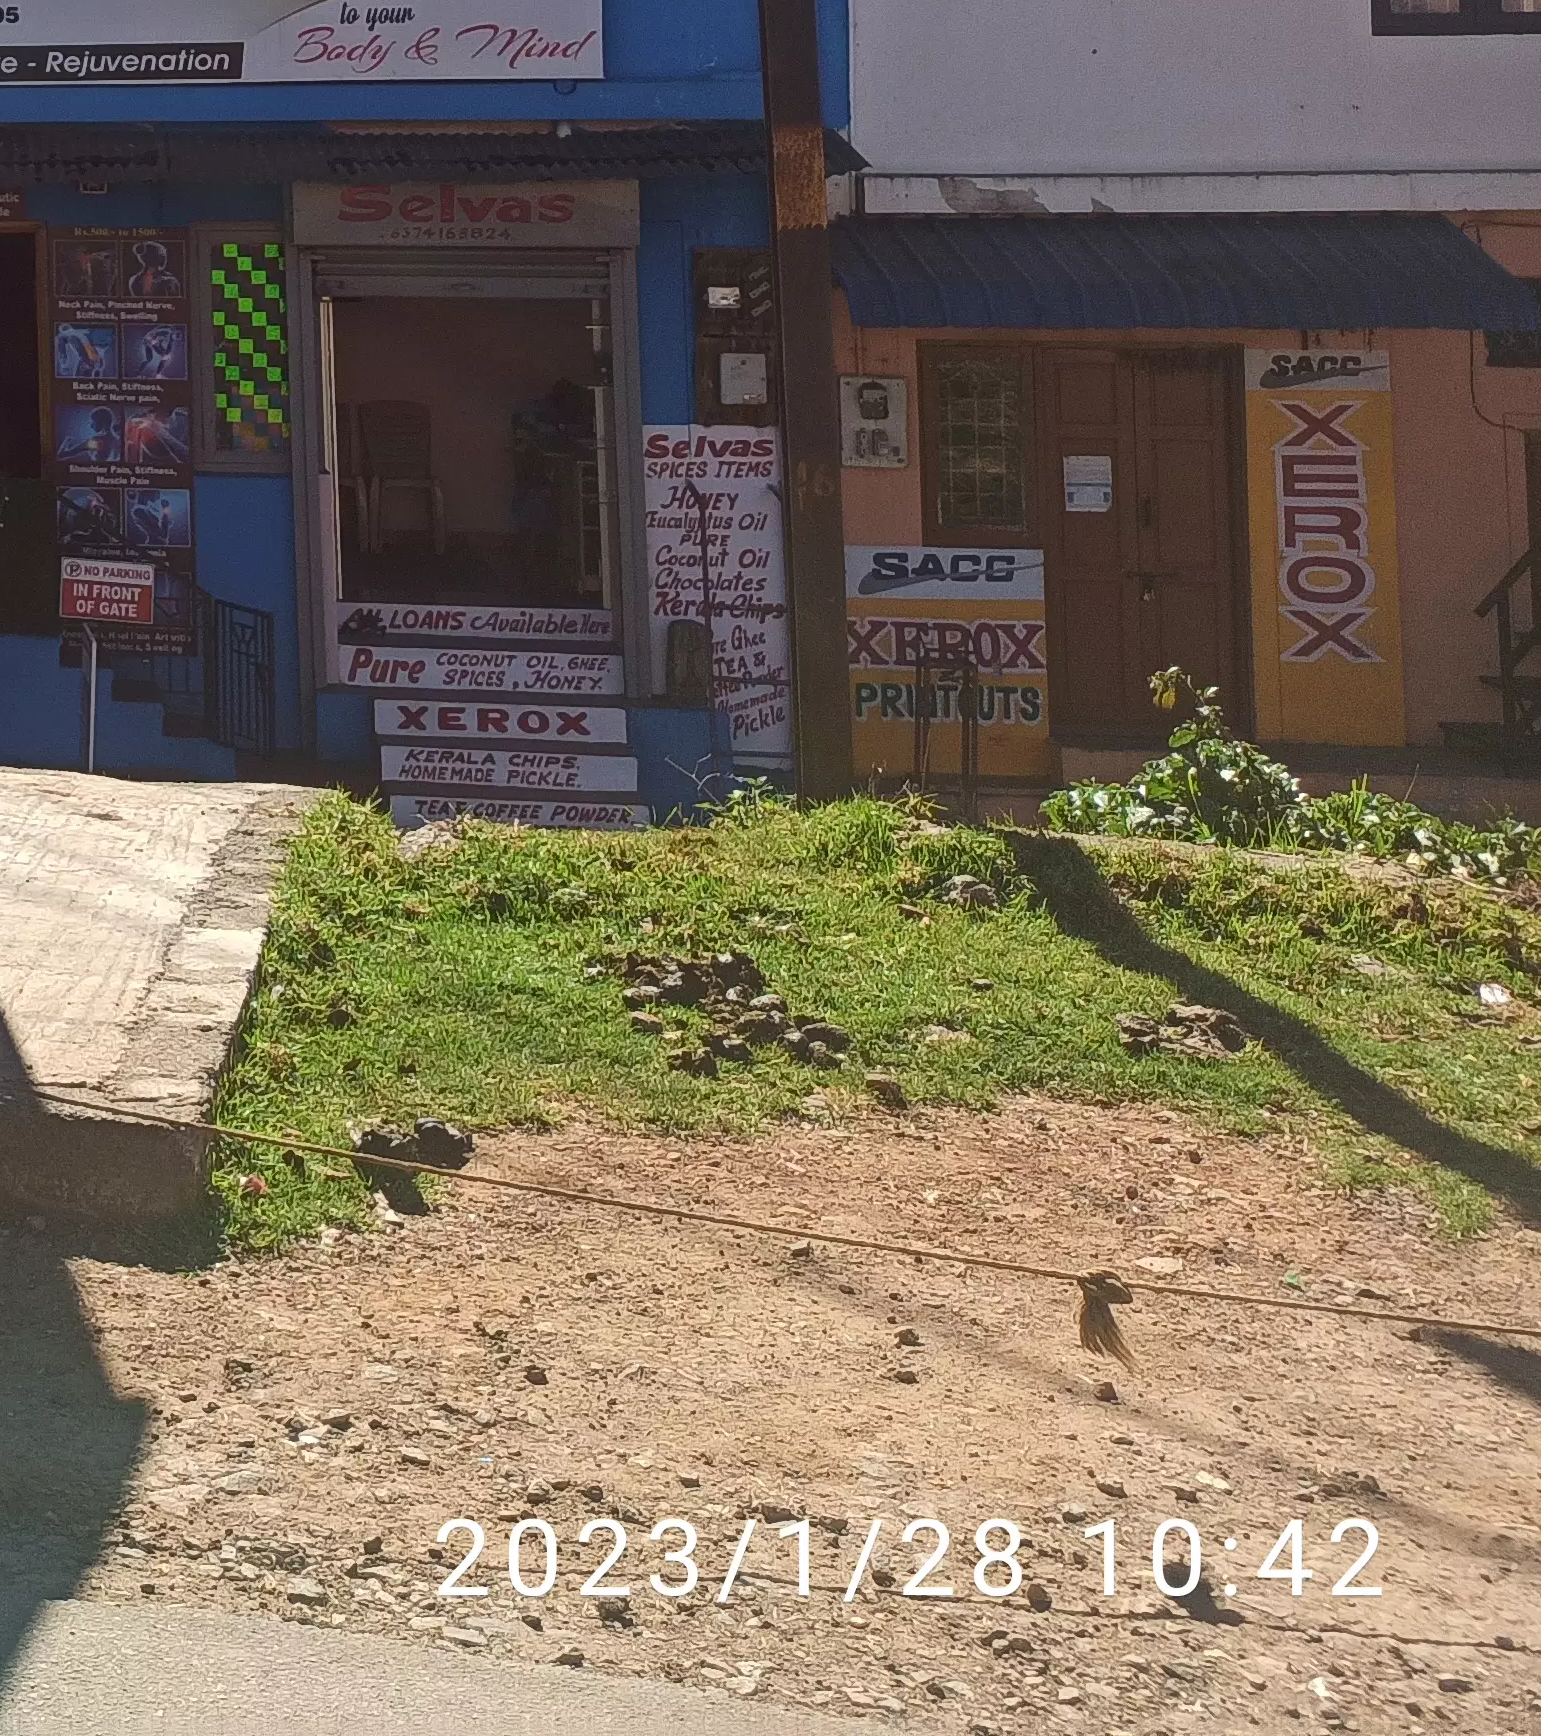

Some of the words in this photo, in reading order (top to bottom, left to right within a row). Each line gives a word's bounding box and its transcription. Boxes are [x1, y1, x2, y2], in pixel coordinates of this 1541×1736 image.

[339, 1, 360, 25] to
[365, 4, 416, 31] your
[294, 26, 397, 73] Body
[404, 27, 441, 65] &
[455, 24, 598, 70] Mind
[46, 48, 231, 78] Rejuvenation
[338, 183, 575, 224] Selvas
[644, 433, 774, 459] Selvas
[645, 461, 708, 480] SPICES
[713, 460, 774, 479] ITEMS
[738, 512, 768, 532] Oil
[1272, 401, 1383, 661] XEROX
[738, 547, 771, 569] Oil
[83, 565, 99, 577] NO
[102, 566, 151, 581] PARKING
[654, 567, 768, 592] Chocolates
[73, 582, 88, 597] IN
[92, 584, 142, 601] FRONT
[75, 599, 93, 614] OF
[99, 601, 138, 618] GATE
[388, 609, 466, 630] LOANS
[470, 611, 579, 635] Available
[730, 624, 766, 651] Ghee
[846, 619, 1047, 670] XEROX
[347, 647, 427, 684] Pure
[435, 652, 517, 667] COCONUT
[442, 669, 506, 688] SPICES
[714, 655, 749, 677] TEA
[397, 705, 591, 736] XEROX
[732, 704, 786, 741] Pickle
[404, 748, 496, 766] KERALA
[471, 802, 543, 820] COFFEE
